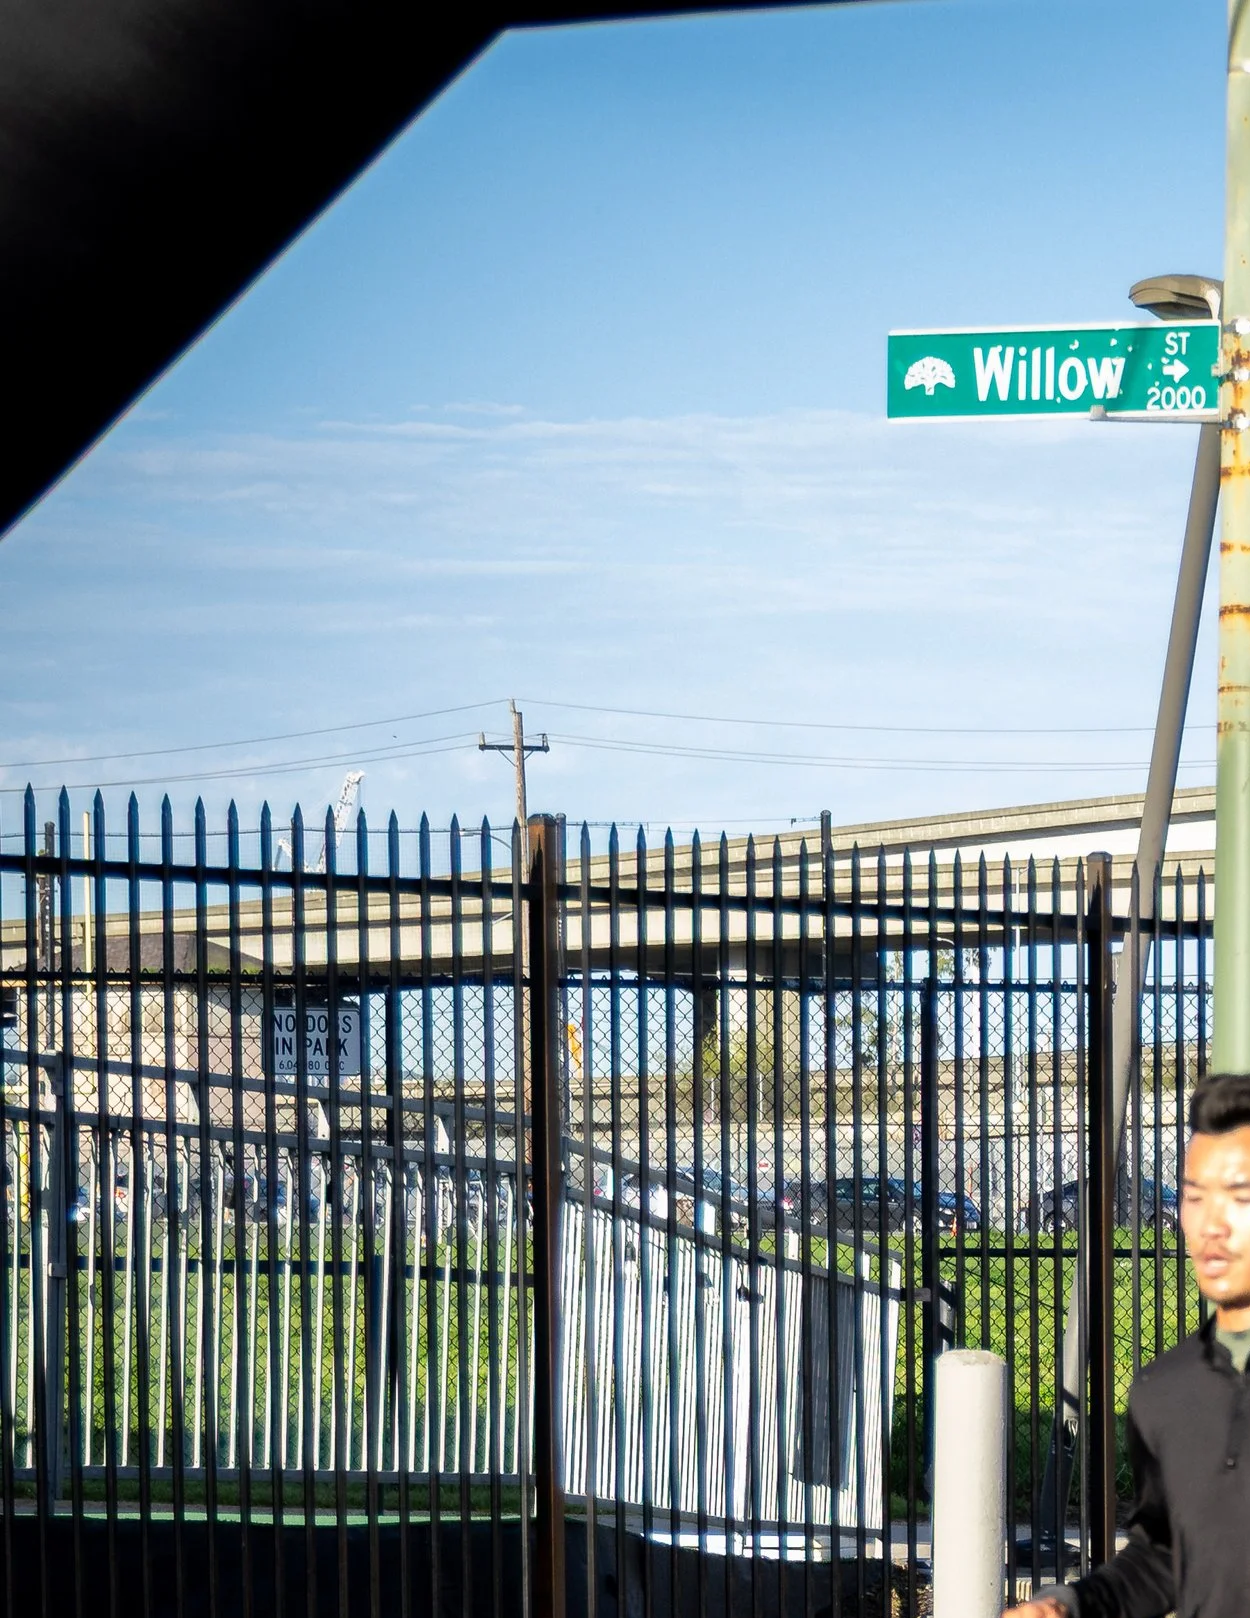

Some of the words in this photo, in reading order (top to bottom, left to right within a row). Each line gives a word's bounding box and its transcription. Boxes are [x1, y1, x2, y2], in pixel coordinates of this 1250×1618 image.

[1164, 332, 1191, 355] ST
[973, 346, 1126, 401] Willow
[1146, 385, 1207, 410] 2000
[304, 1015, 352, 1034] DOS
[275, 1037, 293, 1056] IN
